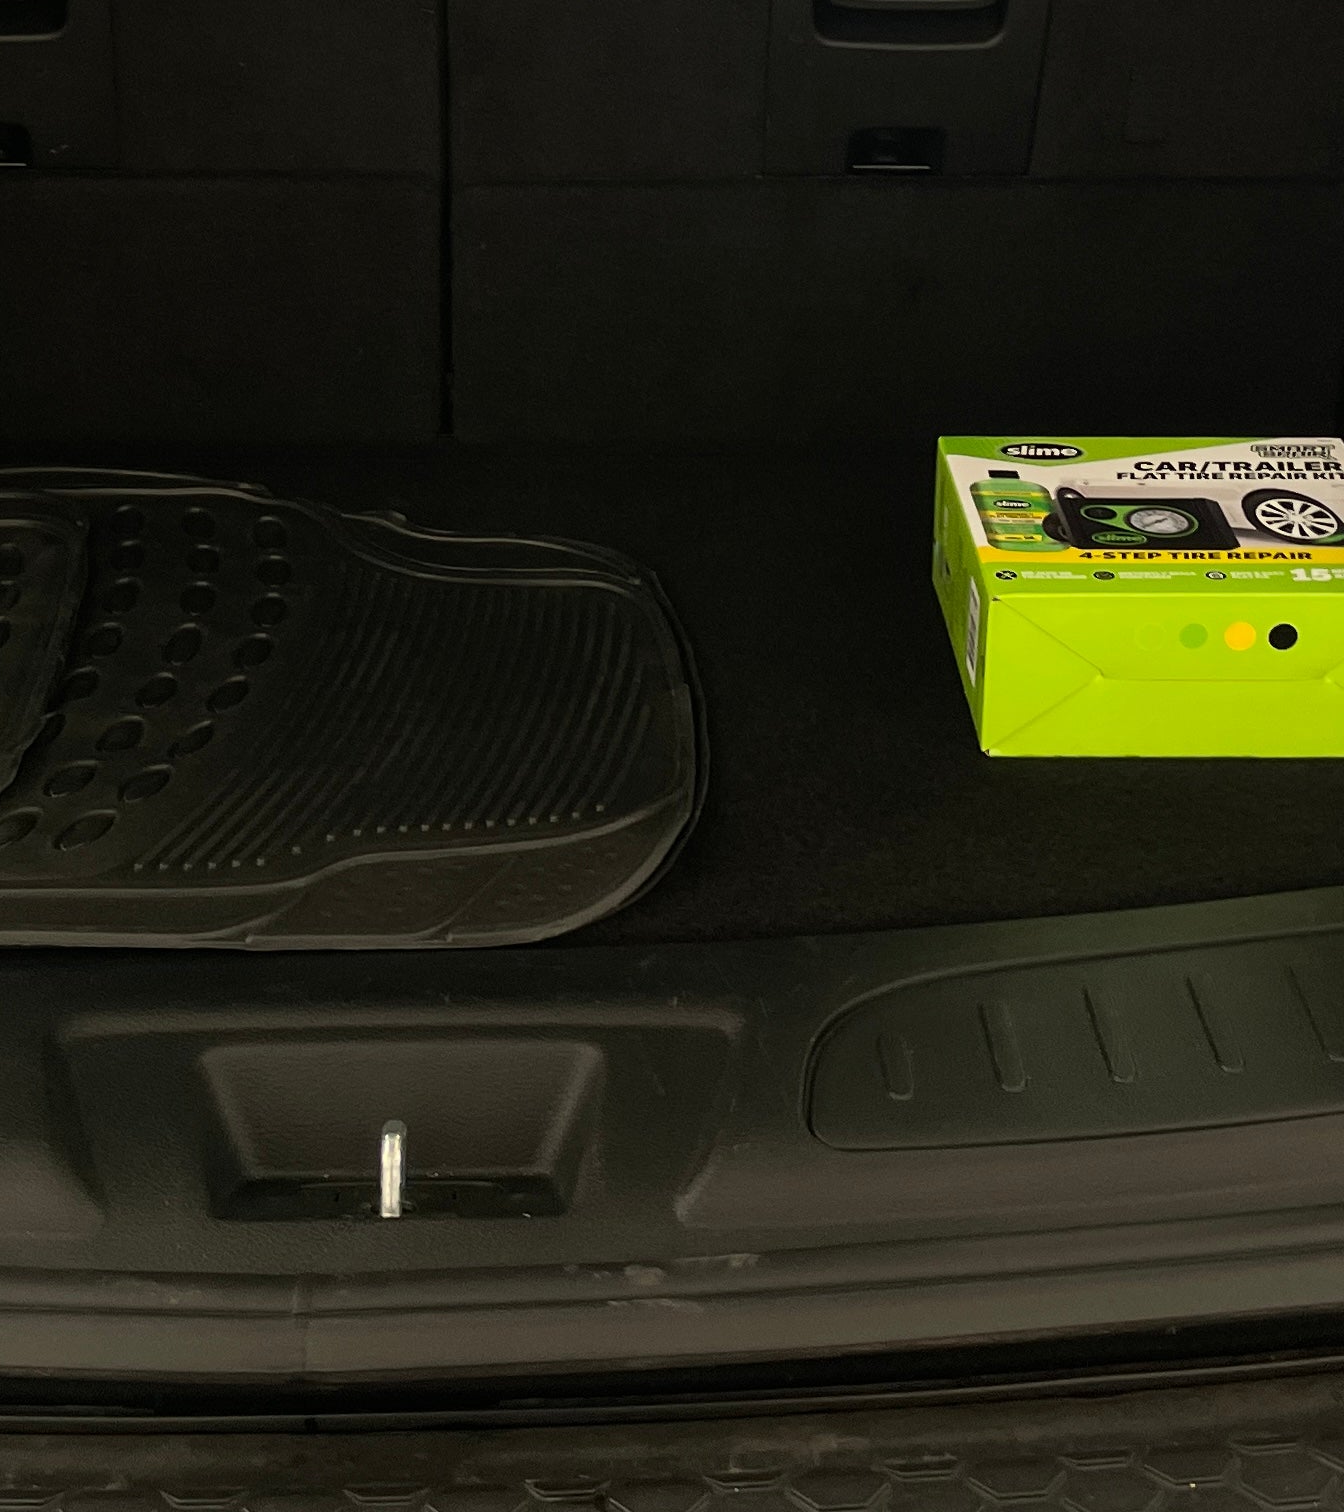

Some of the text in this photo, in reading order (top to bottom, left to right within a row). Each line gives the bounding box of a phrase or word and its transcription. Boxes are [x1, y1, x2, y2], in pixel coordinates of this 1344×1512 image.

[1006, 445, 1078, 457] slime
[1133, 461, 1343, 472] CAR/TRAILER
[1116, 472, 1171, 480] FLAT
[1175, 472, 1225, 480] TIRE
[1229, 472, 1311, 480] REPAIR
[1079, 551, 1313, 560] 4-STEP TIRE REPAIR
[1290, 568, 1332, 582] 15
